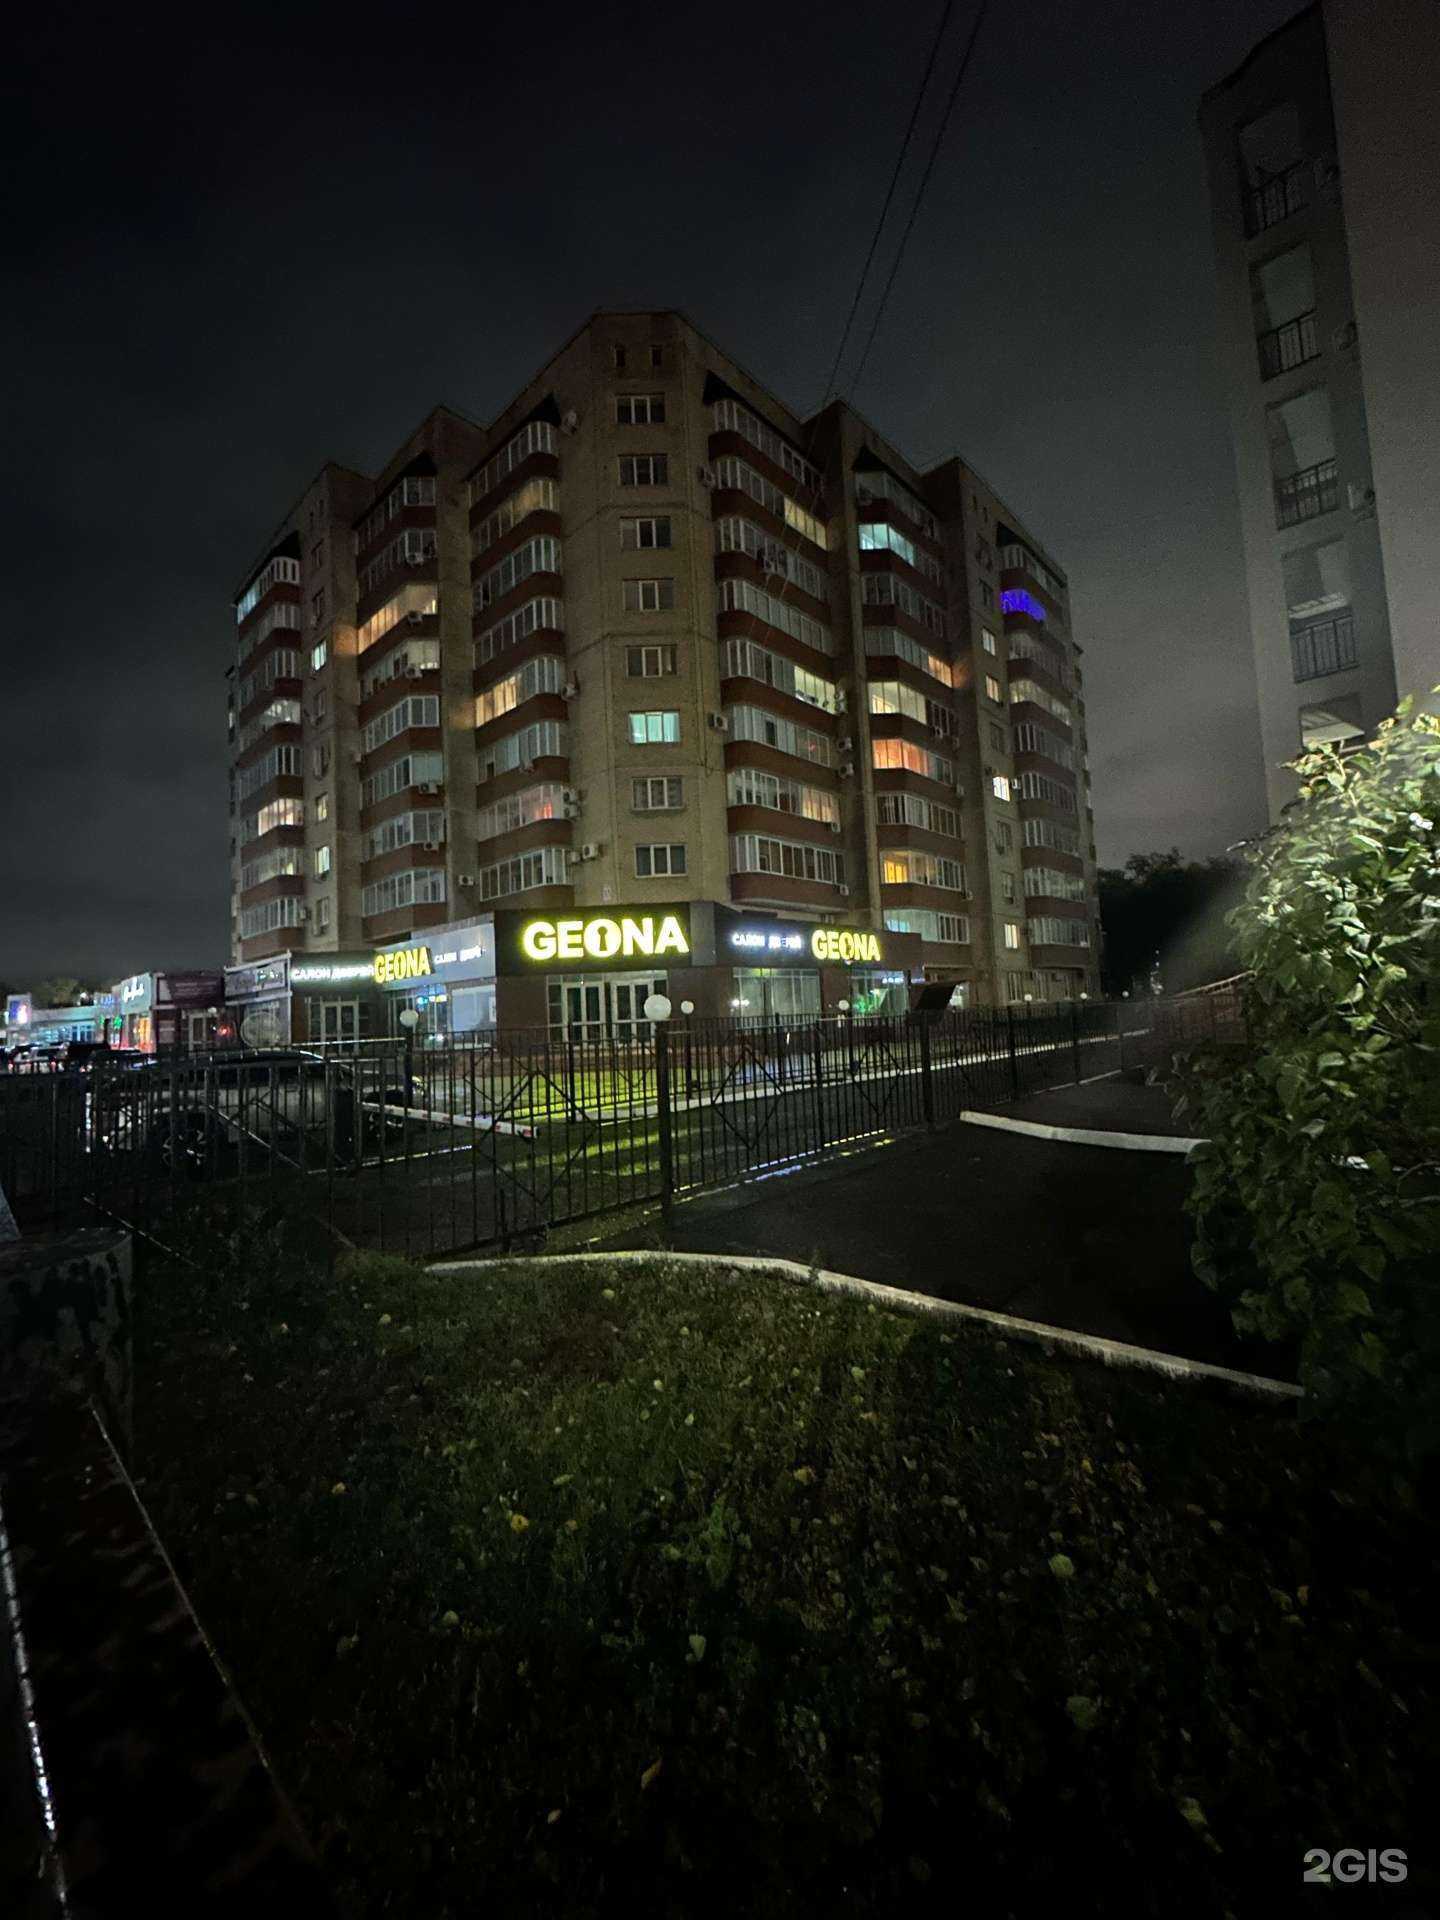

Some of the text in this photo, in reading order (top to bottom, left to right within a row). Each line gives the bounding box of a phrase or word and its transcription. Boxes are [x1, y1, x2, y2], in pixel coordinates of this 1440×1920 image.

[523, 916, 689, 960] GEONA
[812, 929, 881, 961] GEONA
[373, 947, 432, 983] GEONA
